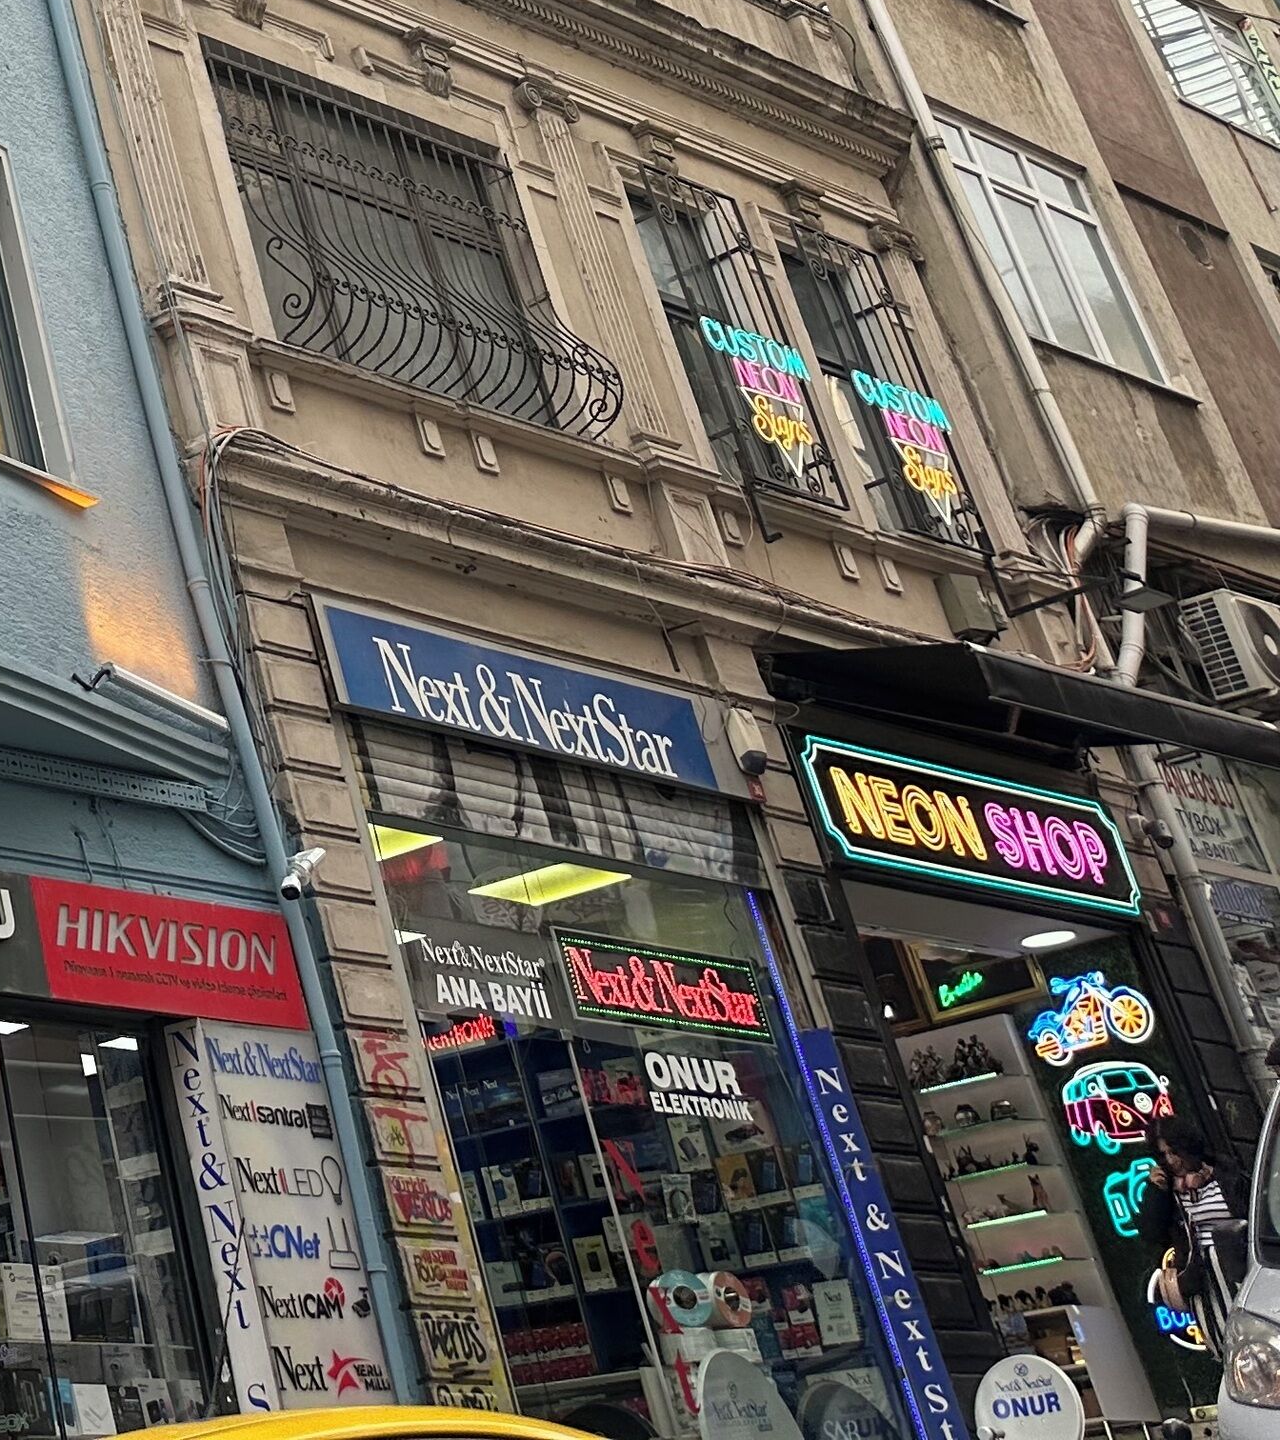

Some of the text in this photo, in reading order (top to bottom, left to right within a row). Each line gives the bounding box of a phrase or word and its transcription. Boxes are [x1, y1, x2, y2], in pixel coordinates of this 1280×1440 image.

[699, 315, 811, 381] CUSTOM
[733, 357, 800, 403] NEON
[851, 369, 952, 435] CUSTOM
[753, 394, 812, 450] Signs
[882, 409, 946, 453] NEON
[903, 446, 957, 499] Signs
[829, 767, 1108, 885] NEON SHOP
[57, 904, 277, 975] HIKVISION
[436, 973, 487, 1010] ANA
[645, 1052, 742, 1096] ONUR
[649, 1091, 754, 1122] ELEKTRONİK
[271, 1346, 329, 1391] Next
[992, 1392, 1061, 1419] ONUR
